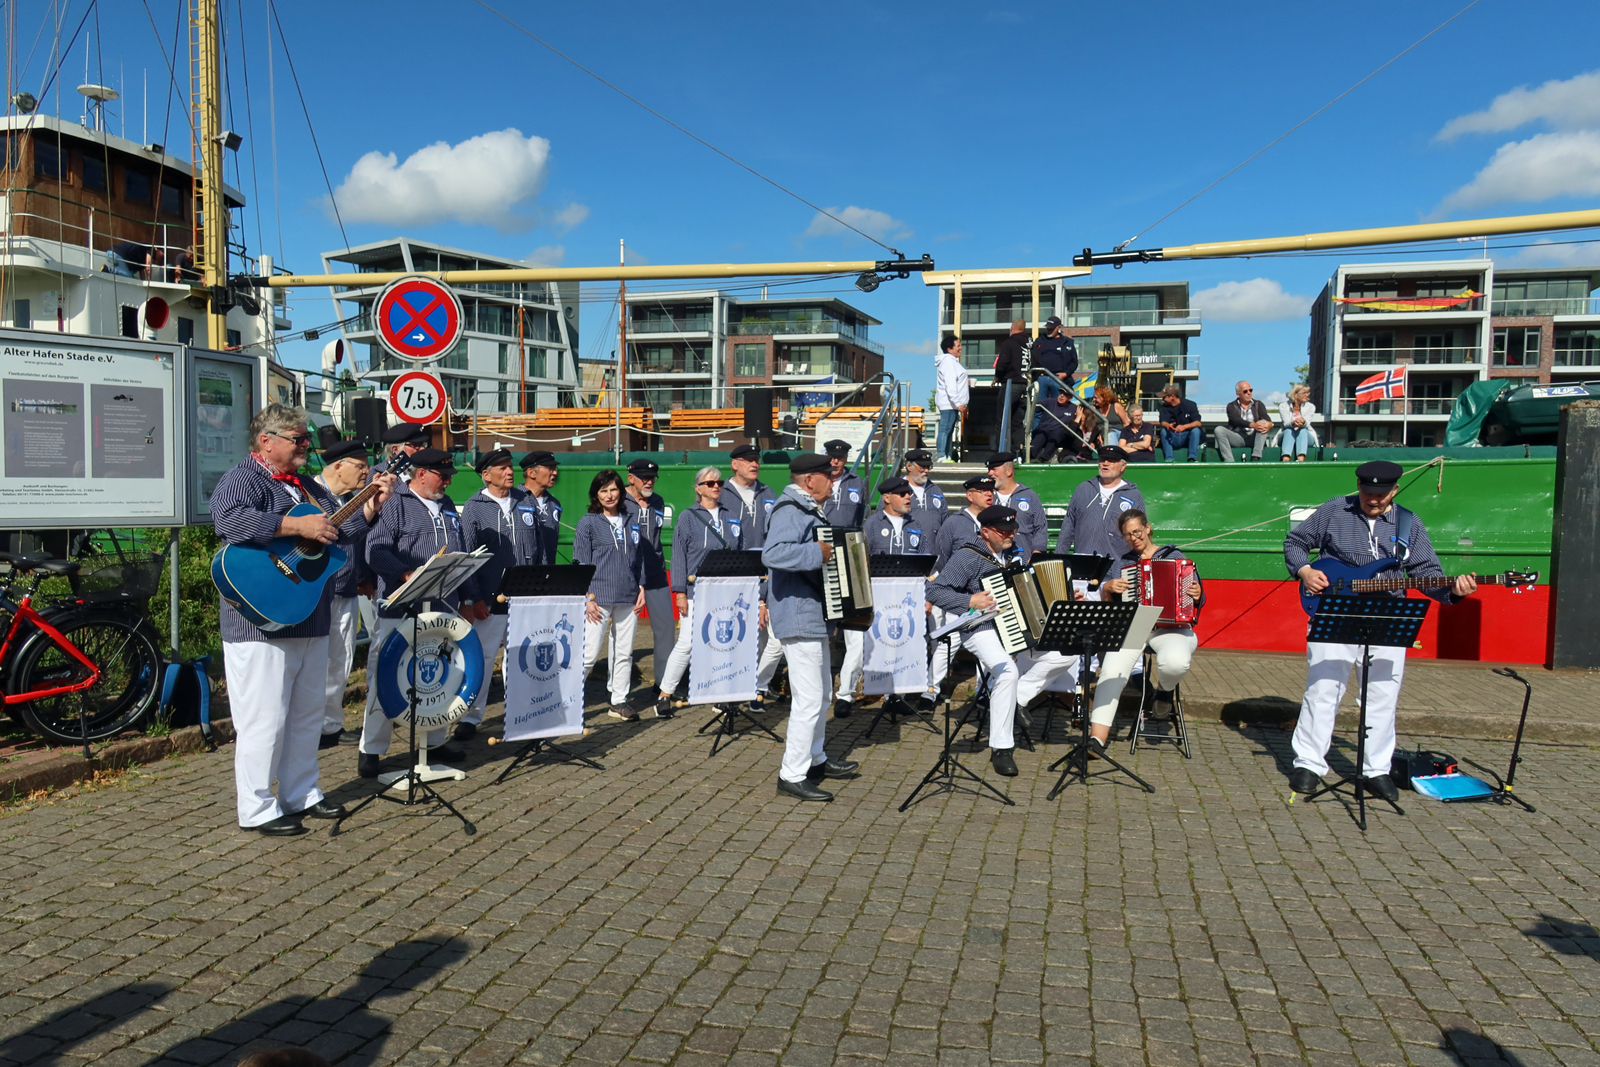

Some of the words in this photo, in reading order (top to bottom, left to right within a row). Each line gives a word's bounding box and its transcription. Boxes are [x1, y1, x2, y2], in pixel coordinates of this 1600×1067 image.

[4, 347, 30, 356] Alter
[33, 350, 64, 359] Hafen
[67, 352, 95, 361] Stade
[97, 355, 115, 363] e.V.
[404, 387, 433, 410] 7,5t
[416, 617, 458, 634] STADER
[531, 628, 555, 638] STADER
[712, 662, 733, 674] Stader
[884, 656, 903, 667] Stader
[697, 671, 738, 691] Hafensänger
[870, 665, 910, 683] Hafensänger
[426, 691, 447, 706] 1977
[530, 691, 554, 706] Stader
[403, 703, 466, 727] HFENSÄNGER
[514, 701, 561, 725] Hafensänger
[563, 695, 576, 706] e.V.
